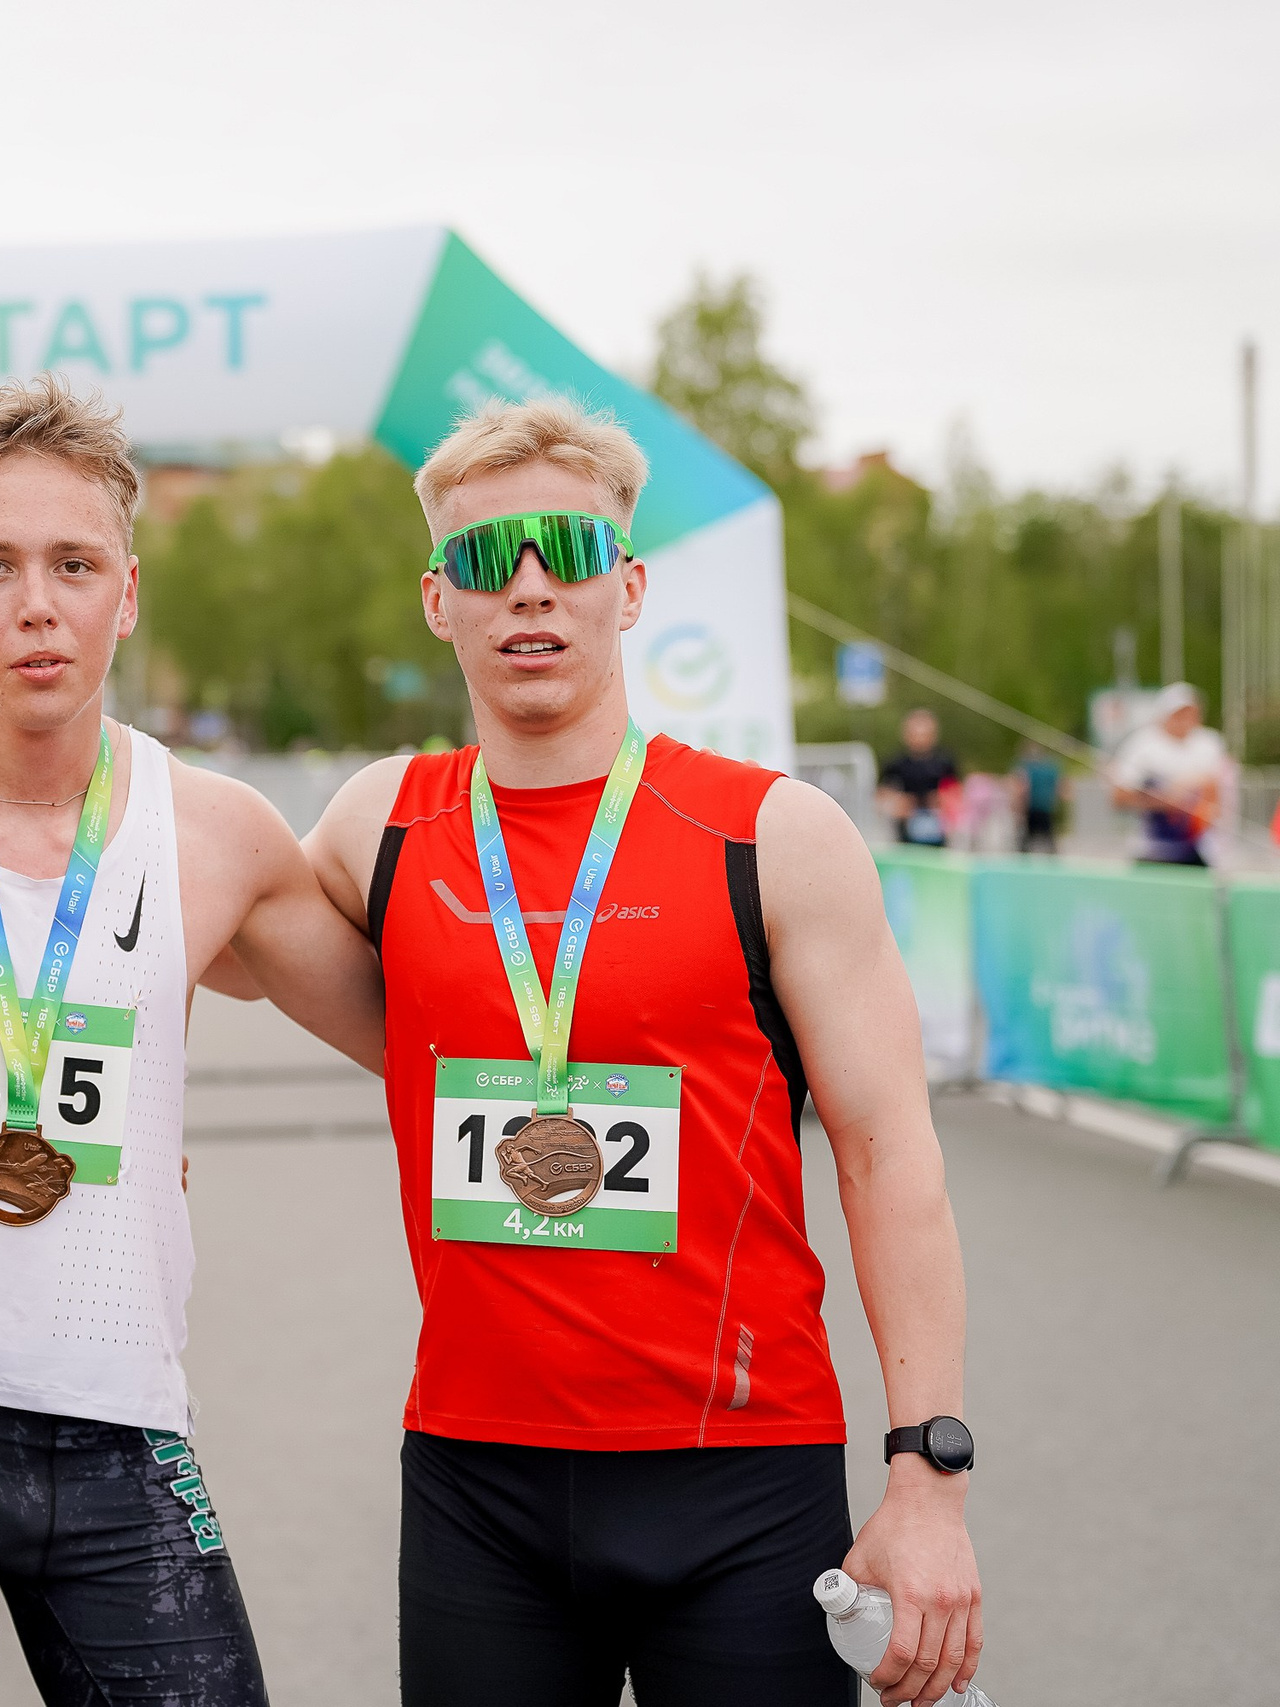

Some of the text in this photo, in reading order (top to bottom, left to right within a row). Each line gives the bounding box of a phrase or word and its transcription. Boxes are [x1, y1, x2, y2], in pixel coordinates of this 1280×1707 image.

[630, 738, 639, 755] 185
[489, 854, 502, 877] Utair
[583, 868, 598, 892] Utair
[67, 889, 82, 915] Utair
[503, 916, 519, 949] СБЕР
[564, 935, 577, 970] СБЕР
[47, 958, 63, 993] СБЕР
[0, 994, 14, 1041] 185 лет
[523, 981, 542, 1027] 185 лет
[552, 986, 567, 1035] 185 лет
[31, 1007, 49, 1054] 185 лет
[491, 1075, 523, 1086] СБЕР
[458, 1114, 650, 1193] 12
[564, 1162, 593, 1172] СБЕР
[503, 1208, 550, 1240] 4,2
